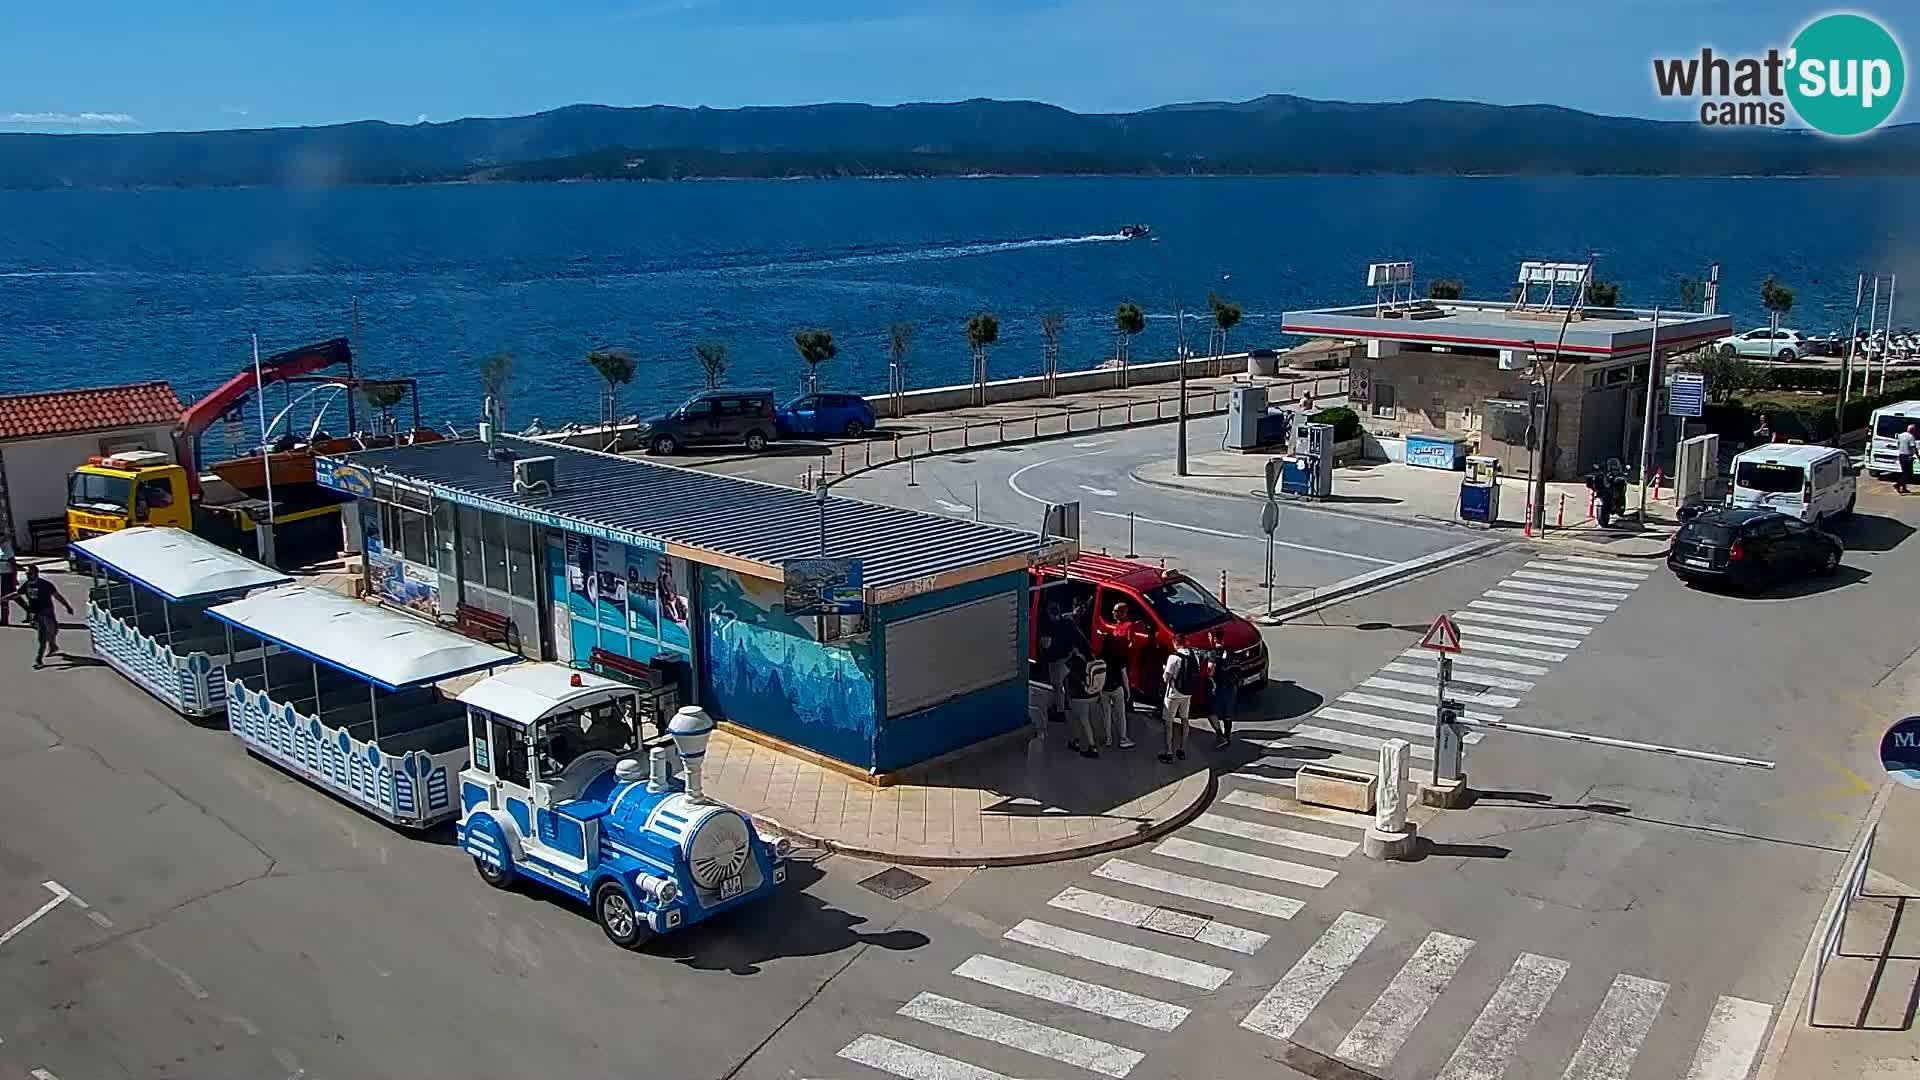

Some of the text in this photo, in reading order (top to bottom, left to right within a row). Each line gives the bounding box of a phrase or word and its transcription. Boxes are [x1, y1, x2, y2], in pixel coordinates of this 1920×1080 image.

[480, 498, 518, 517] AUTOBUSNA
[520, 508, 550, 524] POSTAJA
[560, 518, 574, 531] BUS
[575, 521, 607, 539] STATION
[608, 529, 635, 545] TICKET
[635, 536, 662, 552] OFFICE
